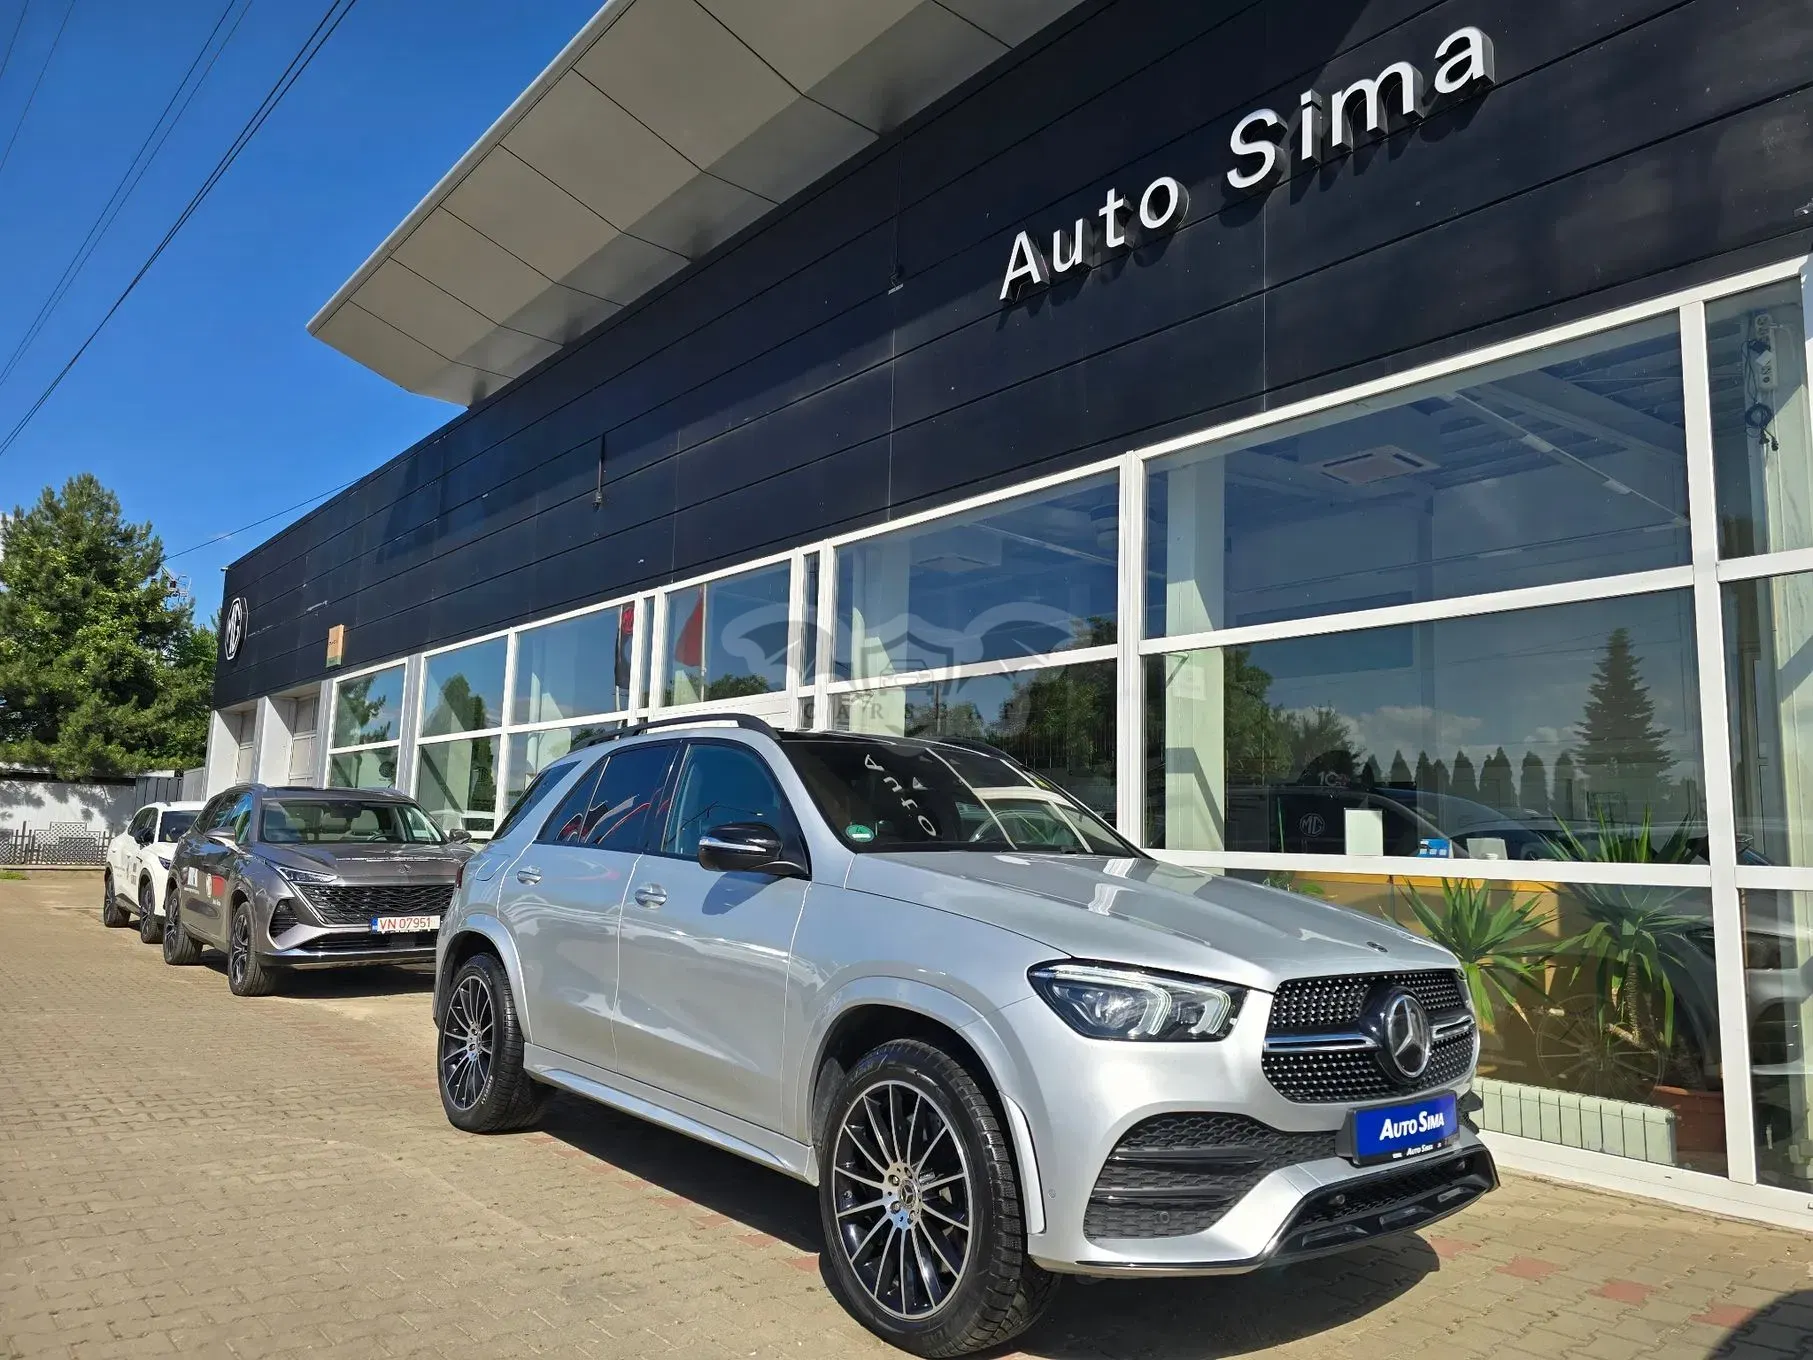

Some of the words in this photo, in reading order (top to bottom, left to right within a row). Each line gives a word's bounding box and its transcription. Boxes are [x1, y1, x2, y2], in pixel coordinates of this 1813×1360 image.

[1000, 176, 1183, 301] Auto
[1227, 26, 1490, 188] Sima
[1301, 815, 1324, 836] MG
[380, 919, 397, 930] VN
[400, 918, 431, 929] 07951
[1379, 1118, 1417, 1140] AUTO
[1419, 1111, 1445, 1132] SIMA
